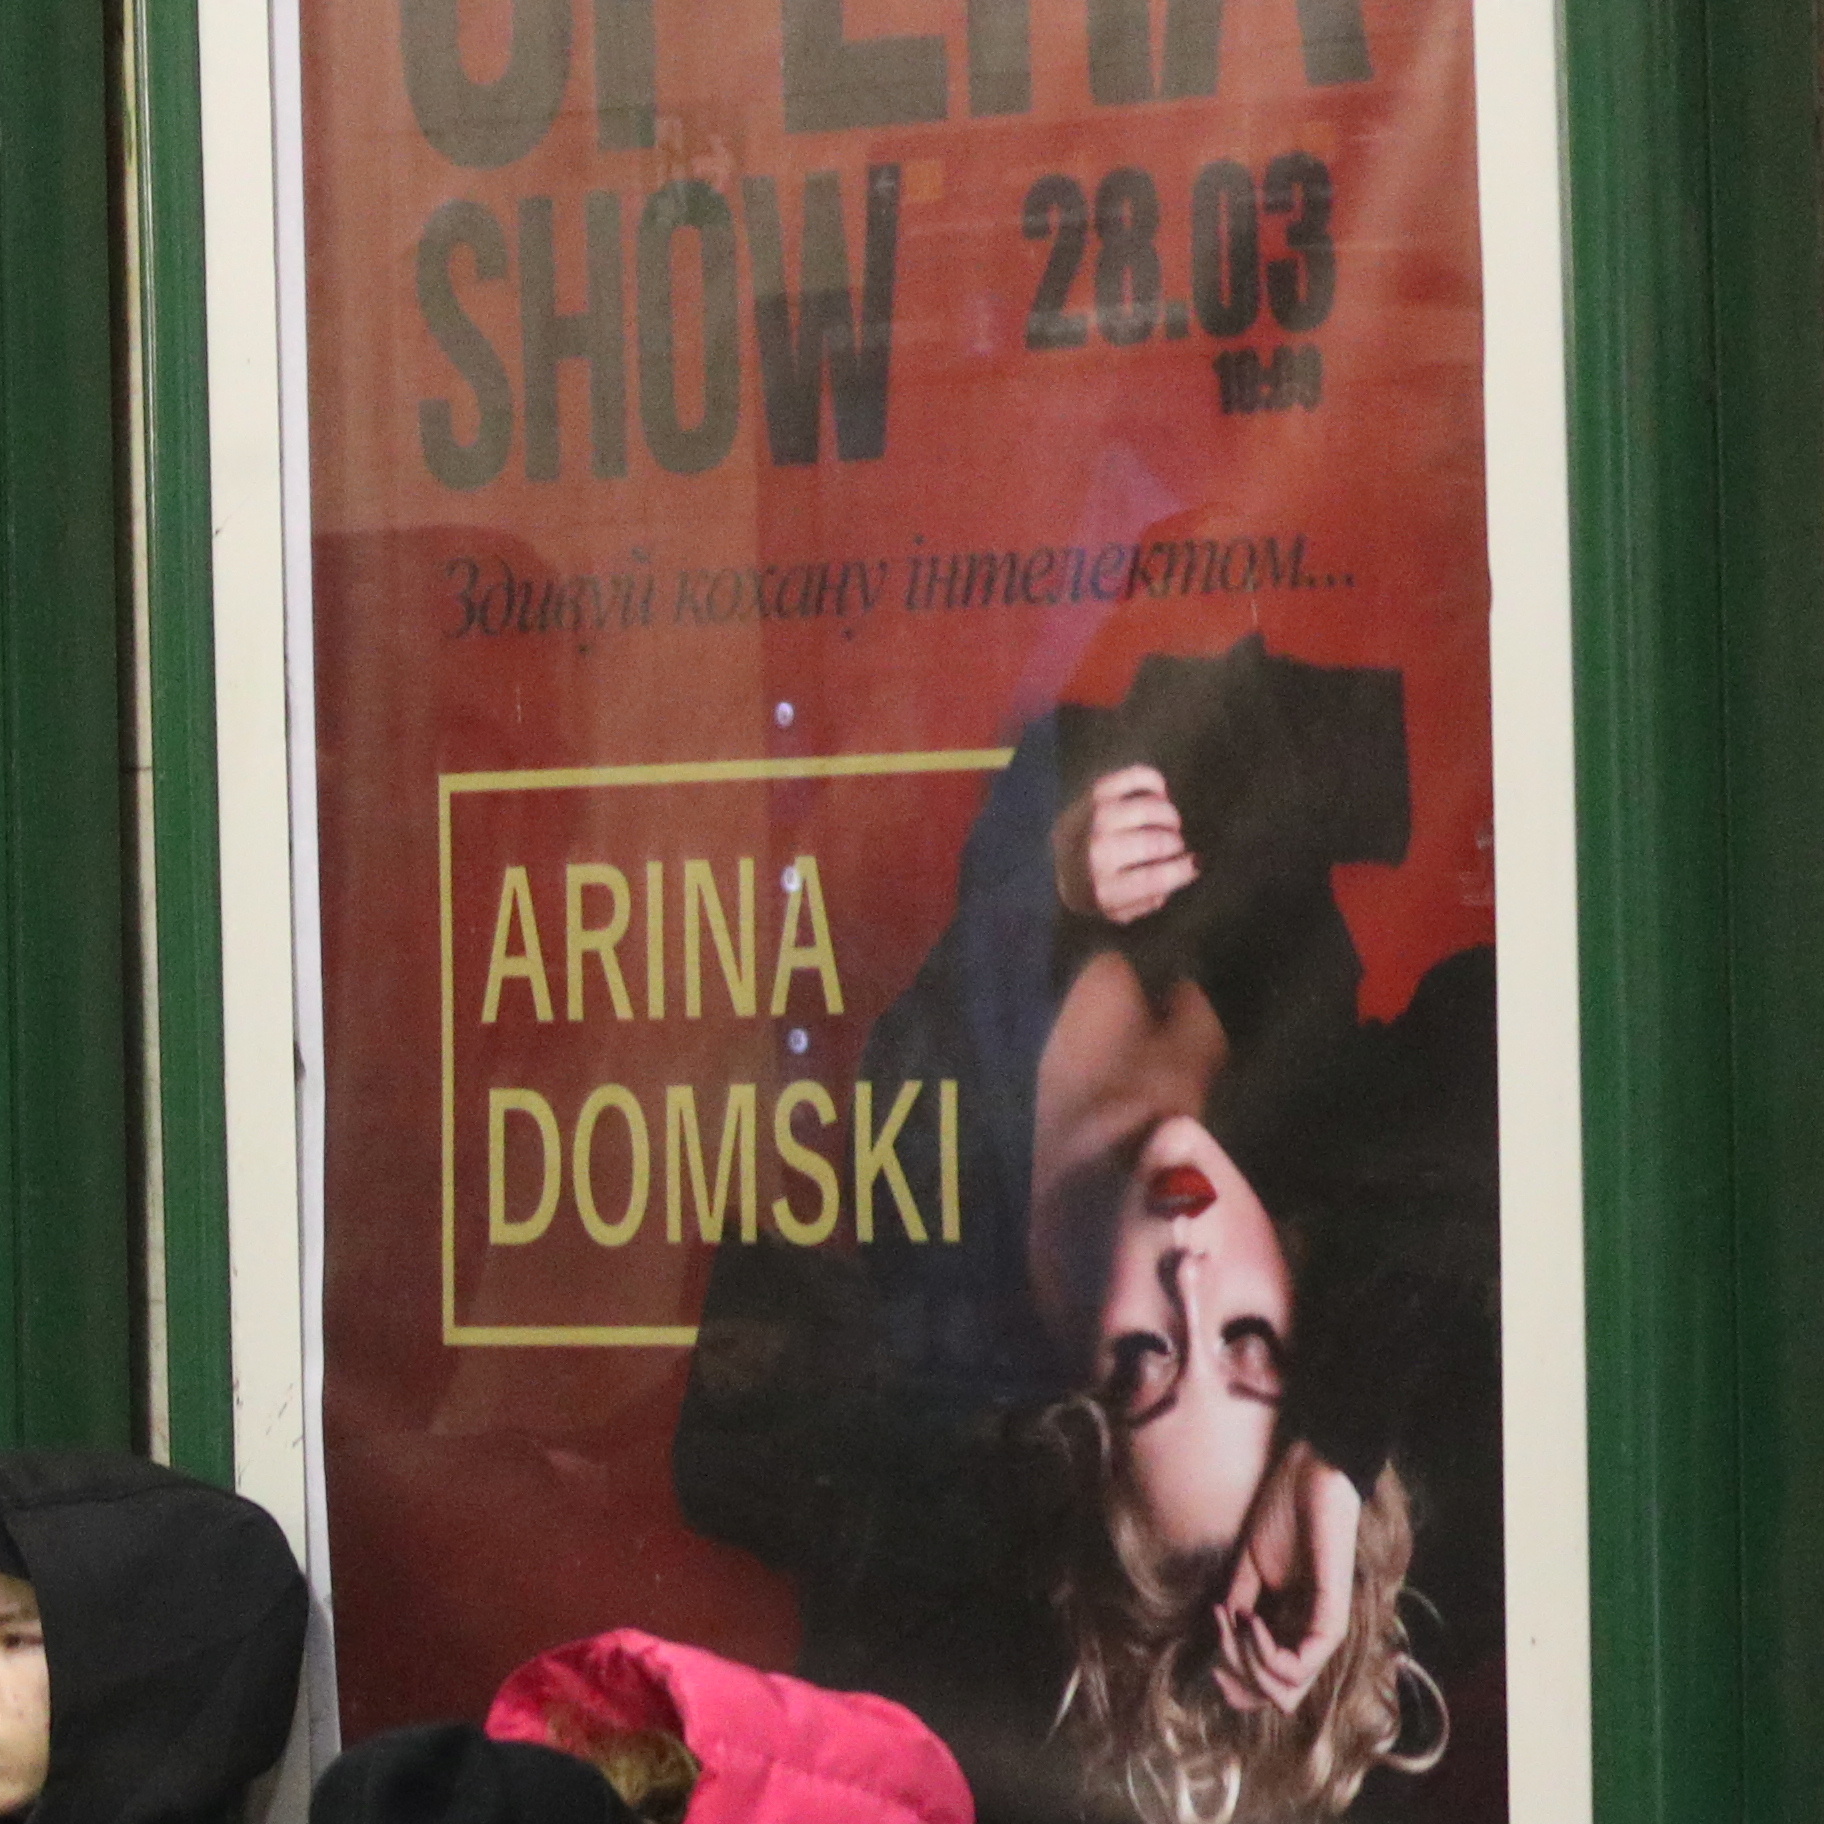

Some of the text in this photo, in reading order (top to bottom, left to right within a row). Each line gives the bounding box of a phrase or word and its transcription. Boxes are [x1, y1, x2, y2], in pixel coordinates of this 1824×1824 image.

[416, 163, 902, 492] SHOW
[1020, 152, 1337, 353] 28.03
[480, 855, 846, 1024] ARINA
[488, 1079, 962, 1248] DOMSKI
